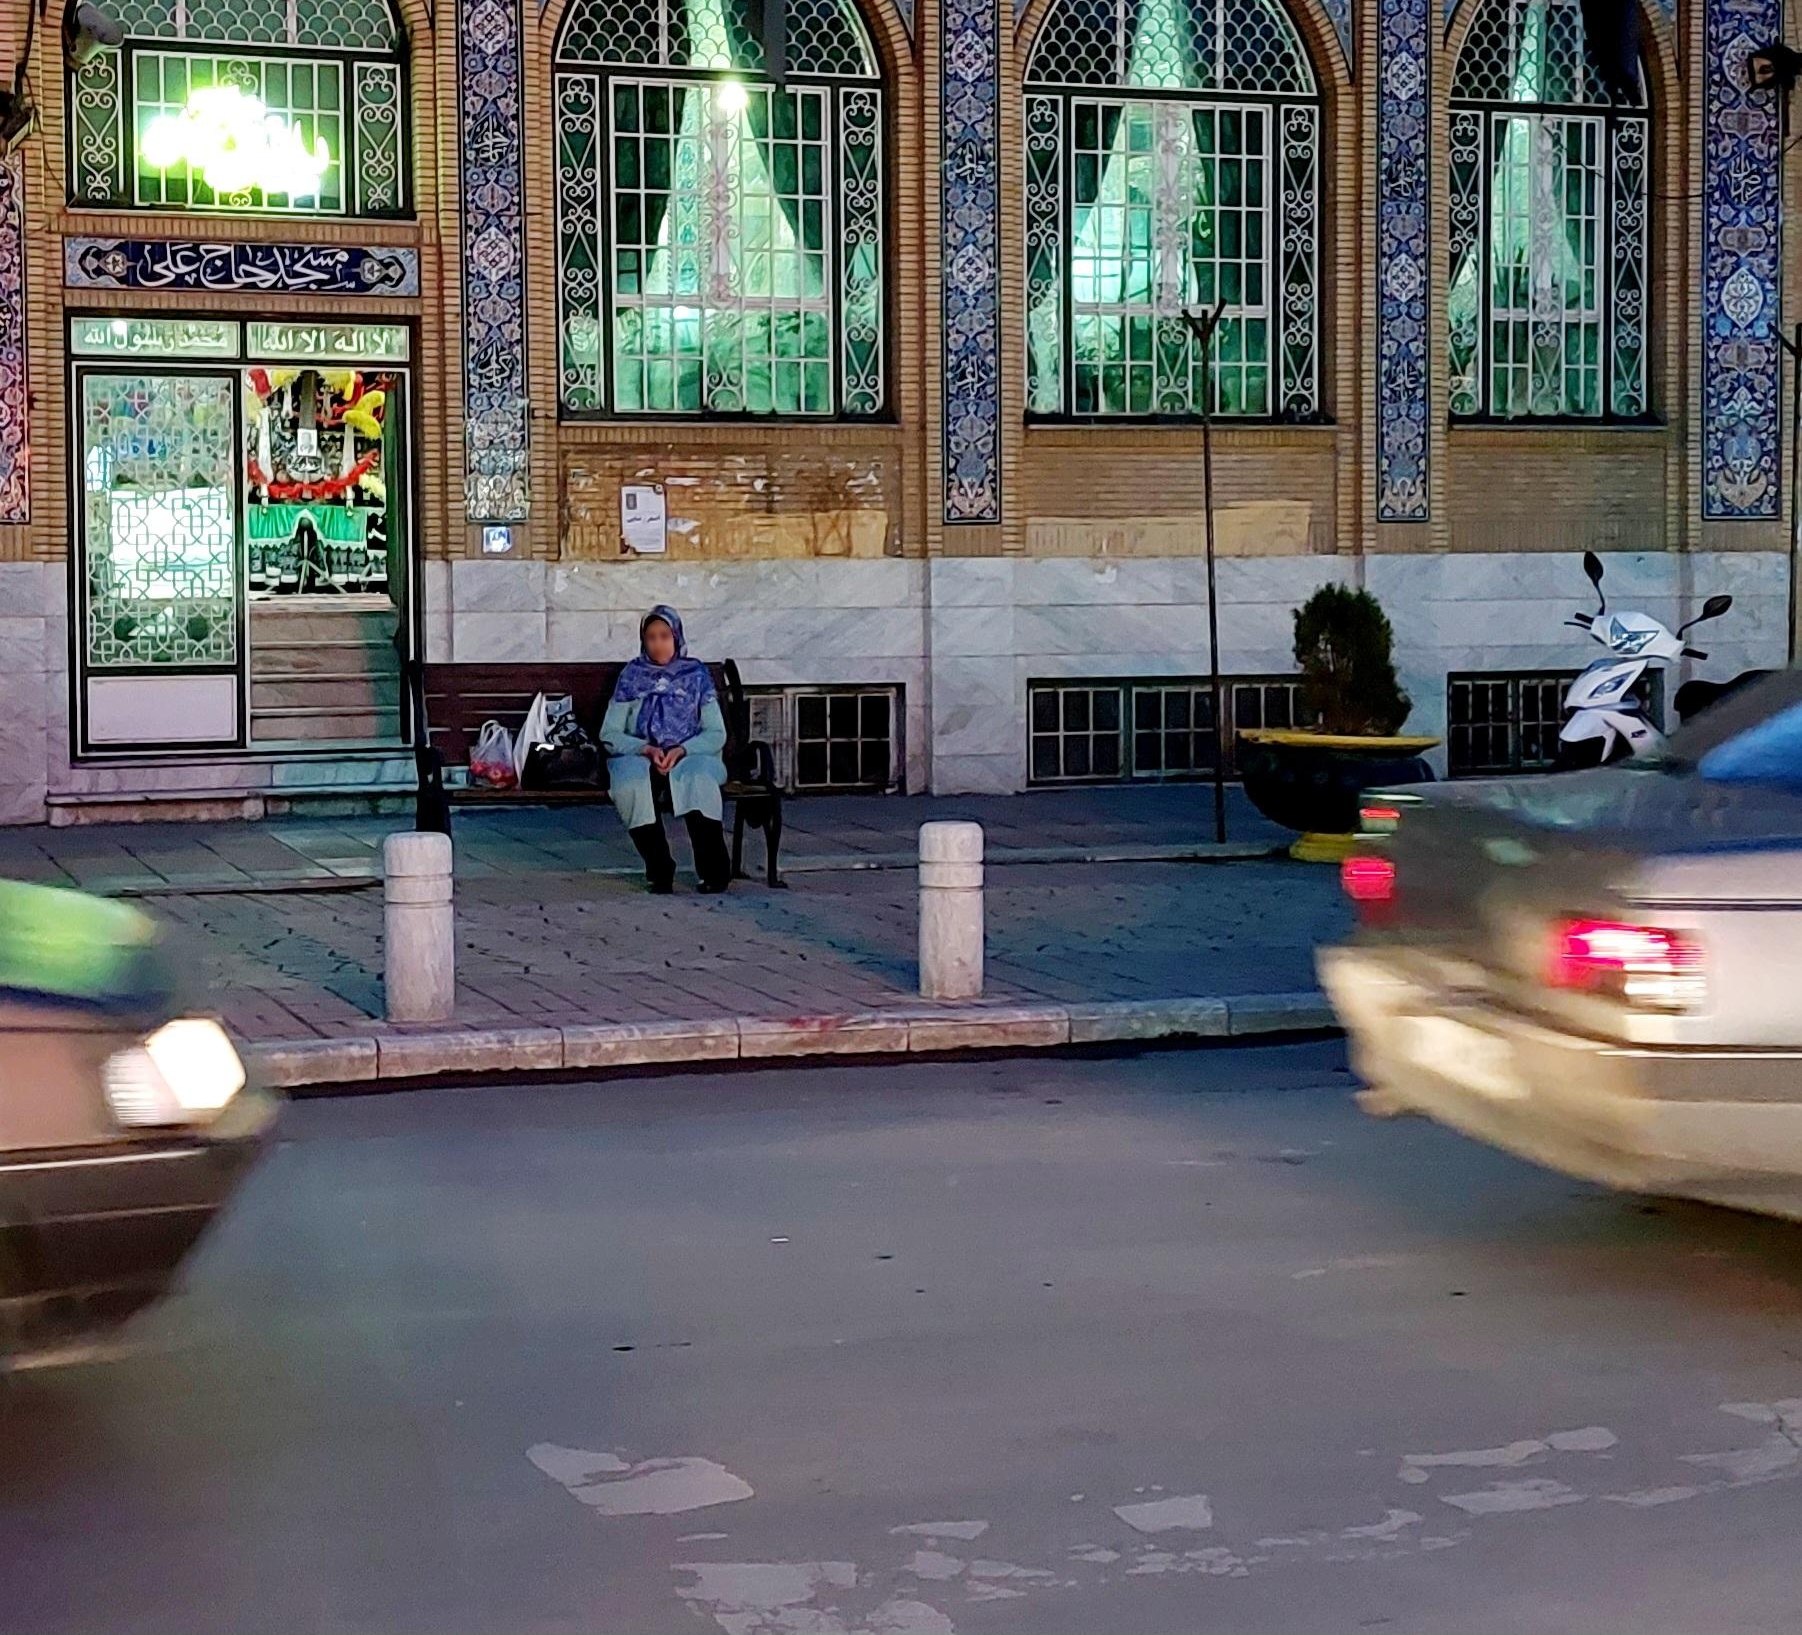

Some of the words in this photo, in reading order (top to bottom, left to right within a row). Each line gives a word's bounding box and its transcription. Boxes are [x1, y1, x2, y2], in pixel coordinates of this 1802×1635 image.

[137, 242, 200, 287] علی
[199, 243, 274, 290] حاج
[273, 247, 349, 290] مسجد
[84, 331, 112, 347] الله
[178, 328, 229, 349] محمد
[262, 330, 295, 352] الله
